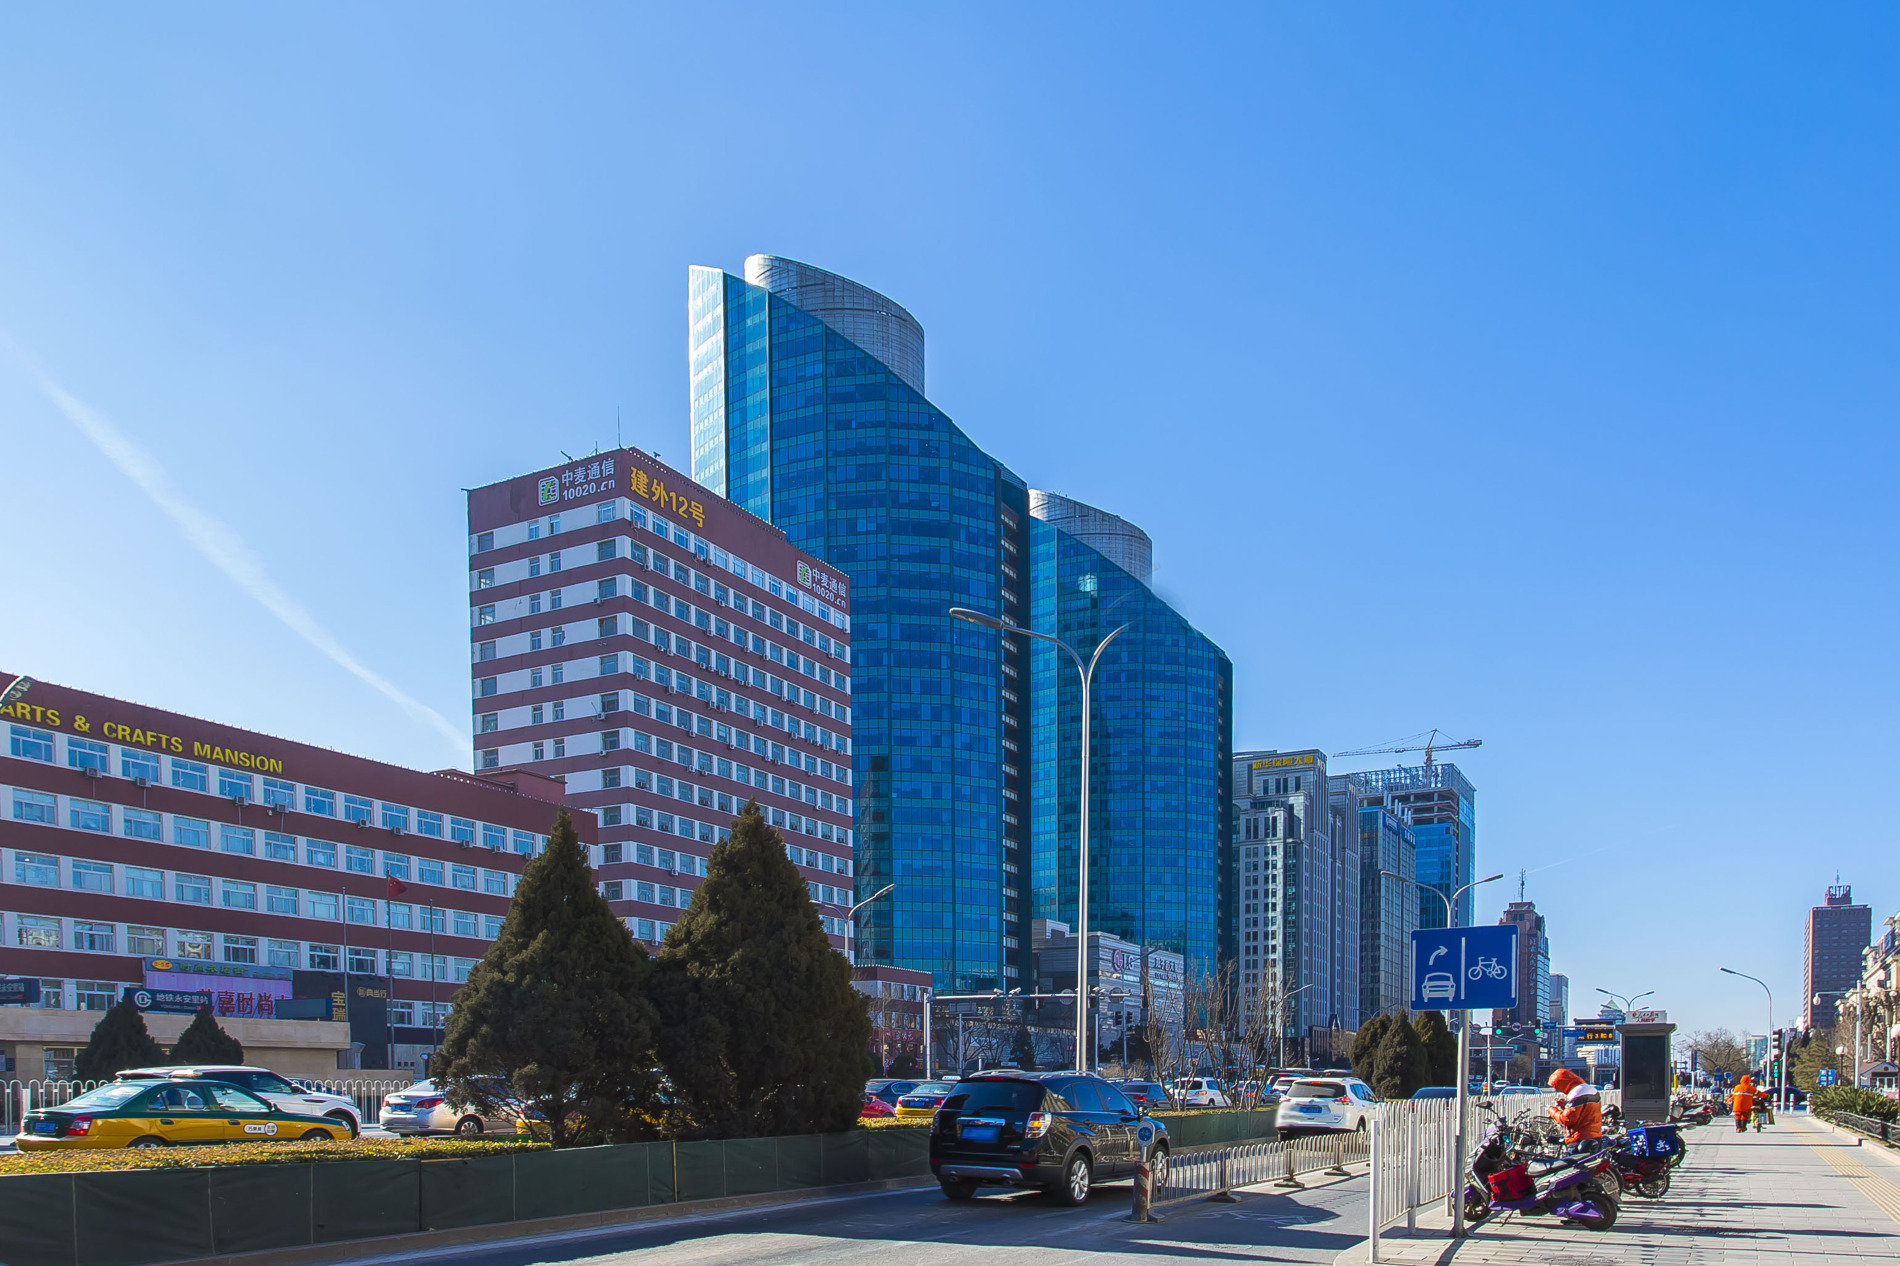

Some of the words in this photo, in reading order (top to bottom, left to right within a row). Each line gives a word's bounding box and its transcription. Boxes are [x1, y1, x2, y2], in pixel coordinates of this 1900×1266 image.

[561, 457, 615, 487] 中麦通信
[562, 479, 616, 501] 10020.cn
[630, 465, 706, 528] 建外12号
[811, 567, 847, 598] 中麦通信
[812, 583, 847, 609] 10020.cn
[0, 701, 61, 728] ARTS
[73, 714, 91, 734] &
[102, 721, 183, 753] CRAFTS
[193, 740, 283, 775] MANSION
